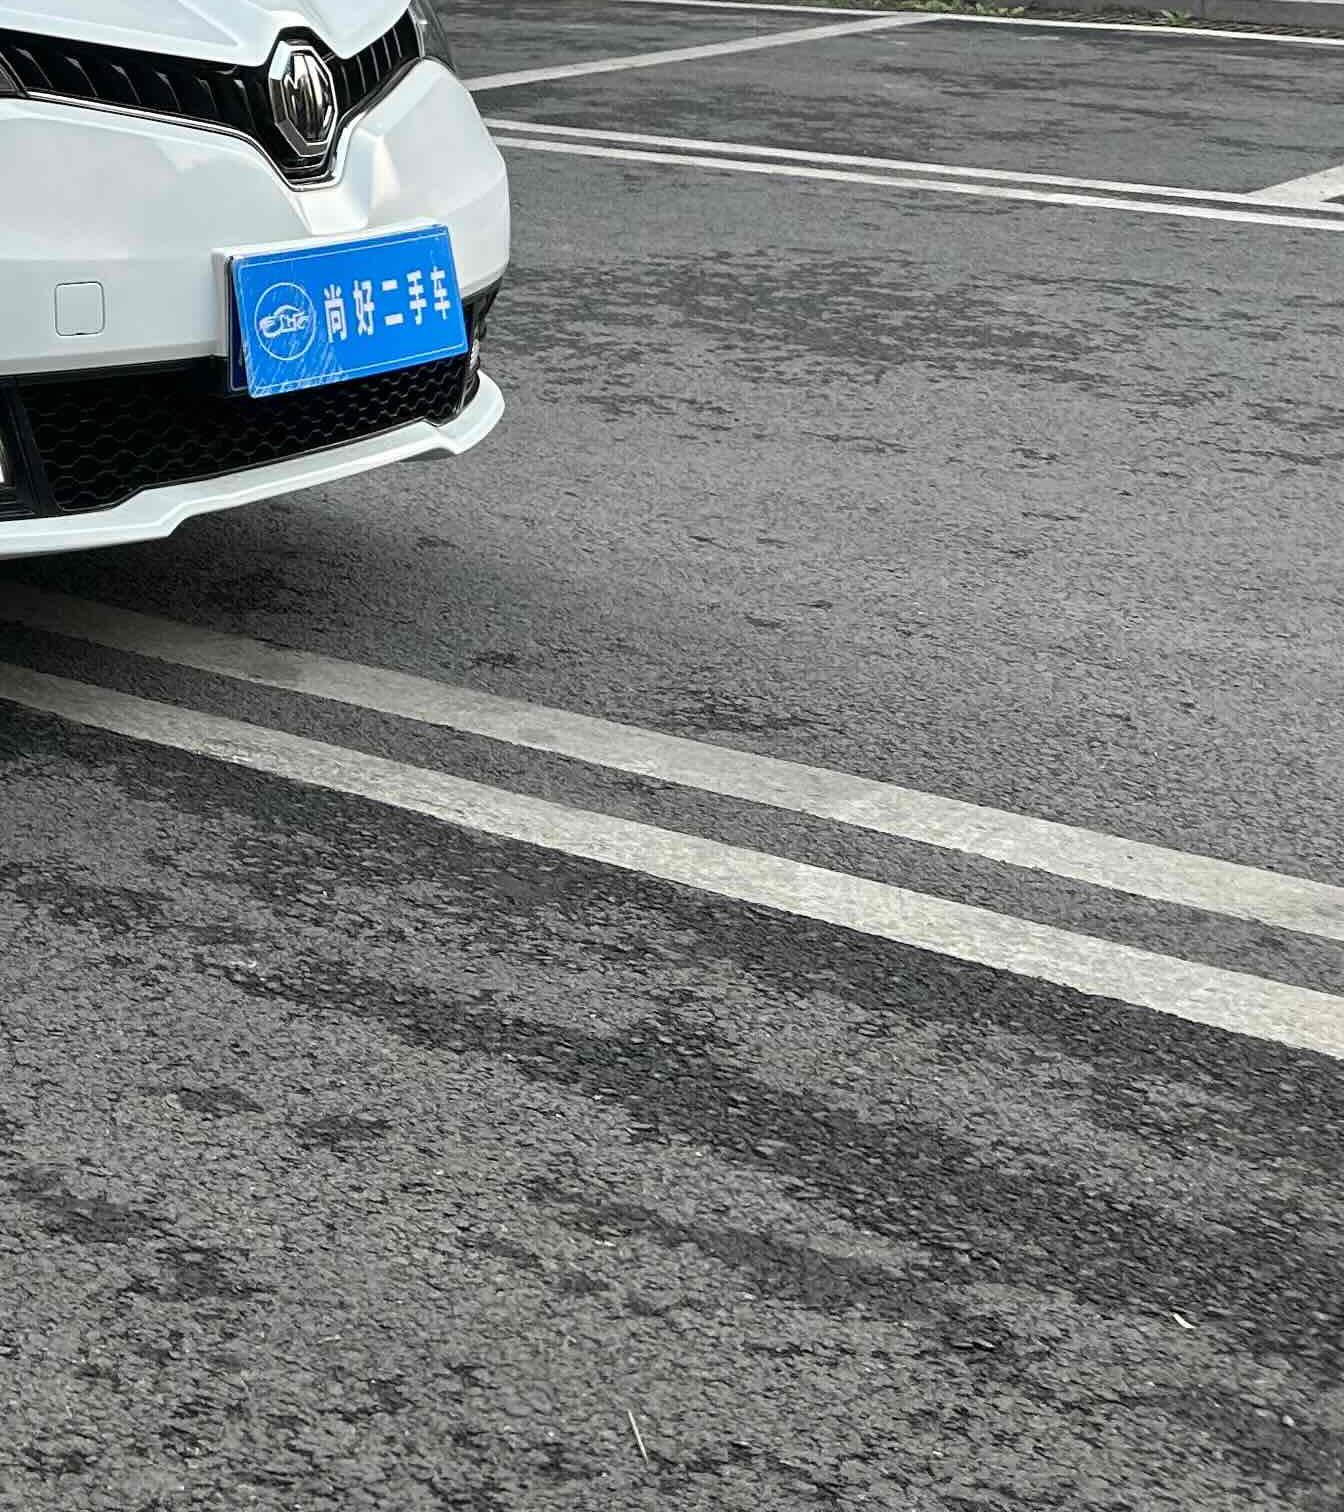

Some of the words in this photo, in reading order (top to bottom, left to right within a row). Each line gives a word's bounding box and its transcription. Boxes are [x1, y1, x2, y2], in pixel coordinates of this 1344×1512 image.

[324, 265, 451, 344] 尚好二手车
